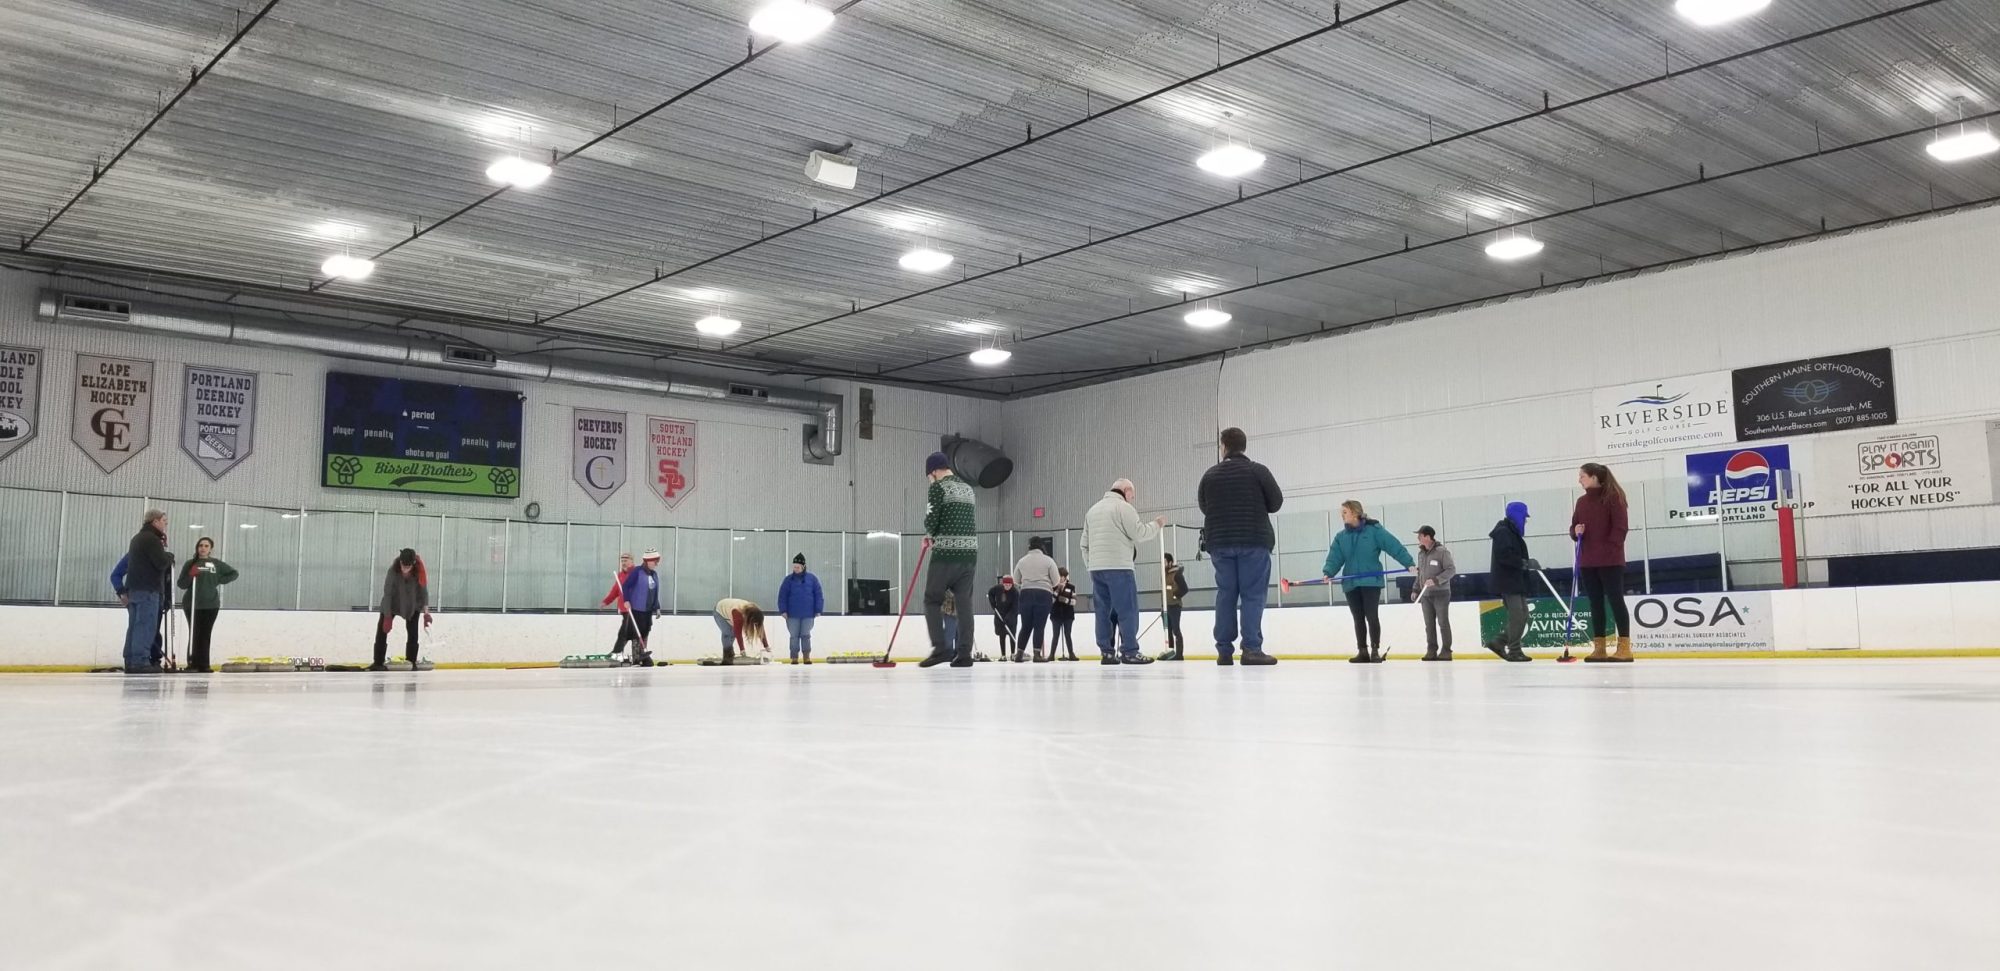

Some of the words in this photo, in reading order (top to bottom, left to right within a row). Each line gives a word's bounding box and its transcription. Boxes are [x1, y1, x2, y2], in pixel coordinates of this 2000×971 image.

[0, 351, 36, 366] LAND
[0, 366, 24, 379] DLE
[100, 362, 130, 377] CAPE
[0, 381, 22, 394] OOL
[82, 375, 147, 393] ELIZABETH
[191, 373, 251, 391] PORTLAND
[1742, 372, 1782, 405] SOUTHERN
[1783, 364, 1812, 379] MAINE
[1814, 362, 1885, 389] ORTHODONTICS
[0, 396, 23, 409] KEY
[90, 390, 136, 406] HOCKEY
[196, 389, 245, 405] DEERING
[197, 403, 241, 419] HOCKEY
[411, 410, 435, 421] period
[1600, 400, 1728, 429] RIVERSIDE
[1756, 413, 1770, 422] 306
[1772, 412, 1786, 421] U.S.
[1788, 410, 1807, 418] Route
[1814, 403, 1857, 415] Scarborough,
[1859, 401, 1873, 410] ME
[578, 418, 623, 435] CHEVERUS
[1655, 422, 1692, 432] COURSE
[1744, 420, 1828, 436] SouthernMaineBraces.com
[1835, 416, 1854, 425] (207)
[200, 424, 236, 435] PORTLAND
[333, 425, 355, 436] player
[364, 428, 394, 441] penalty
[659, 423, 685, 435] SOUTH
[204, 435, 234, 459] DEERING
[461, 437, 489, 448] penalty
[497, 440, 517, 450] player
[584, 435, 617, 451] HOCKEY
[651, 434, 693, 447] PORTLAND
[1607, 431, 1723, 450] riversidegolfcourseme.com
[1861, 443, 1887, 455] PLAY
[1890, 442, 1898, 451] IT
[1902, 439, 1935, 451] AGAIN
[405, 448, 424, 459] shots
[435, 451, 450, 460] goal
[657, 446, 687, 457] HOCKEY
[1861, 448, 1937, 472] SPORTS
[374, 461, 421, 476] Bissell
[420, 464, 474, 477] Brothers
[585, 455, 615, 490] C
[1885, 480, 1910, 492] ALL
[1914, 477, 1952, 489] YOUR
[1708, 485, 1770, 503] PEPSI
[1851, 495, 1904, 510] HOCKEY
[1669, 510, 1703, 519] PEPSI
[1716, 513, 1766, 522] ORTLAND
[1634, 596, 1745, 628] OSA
